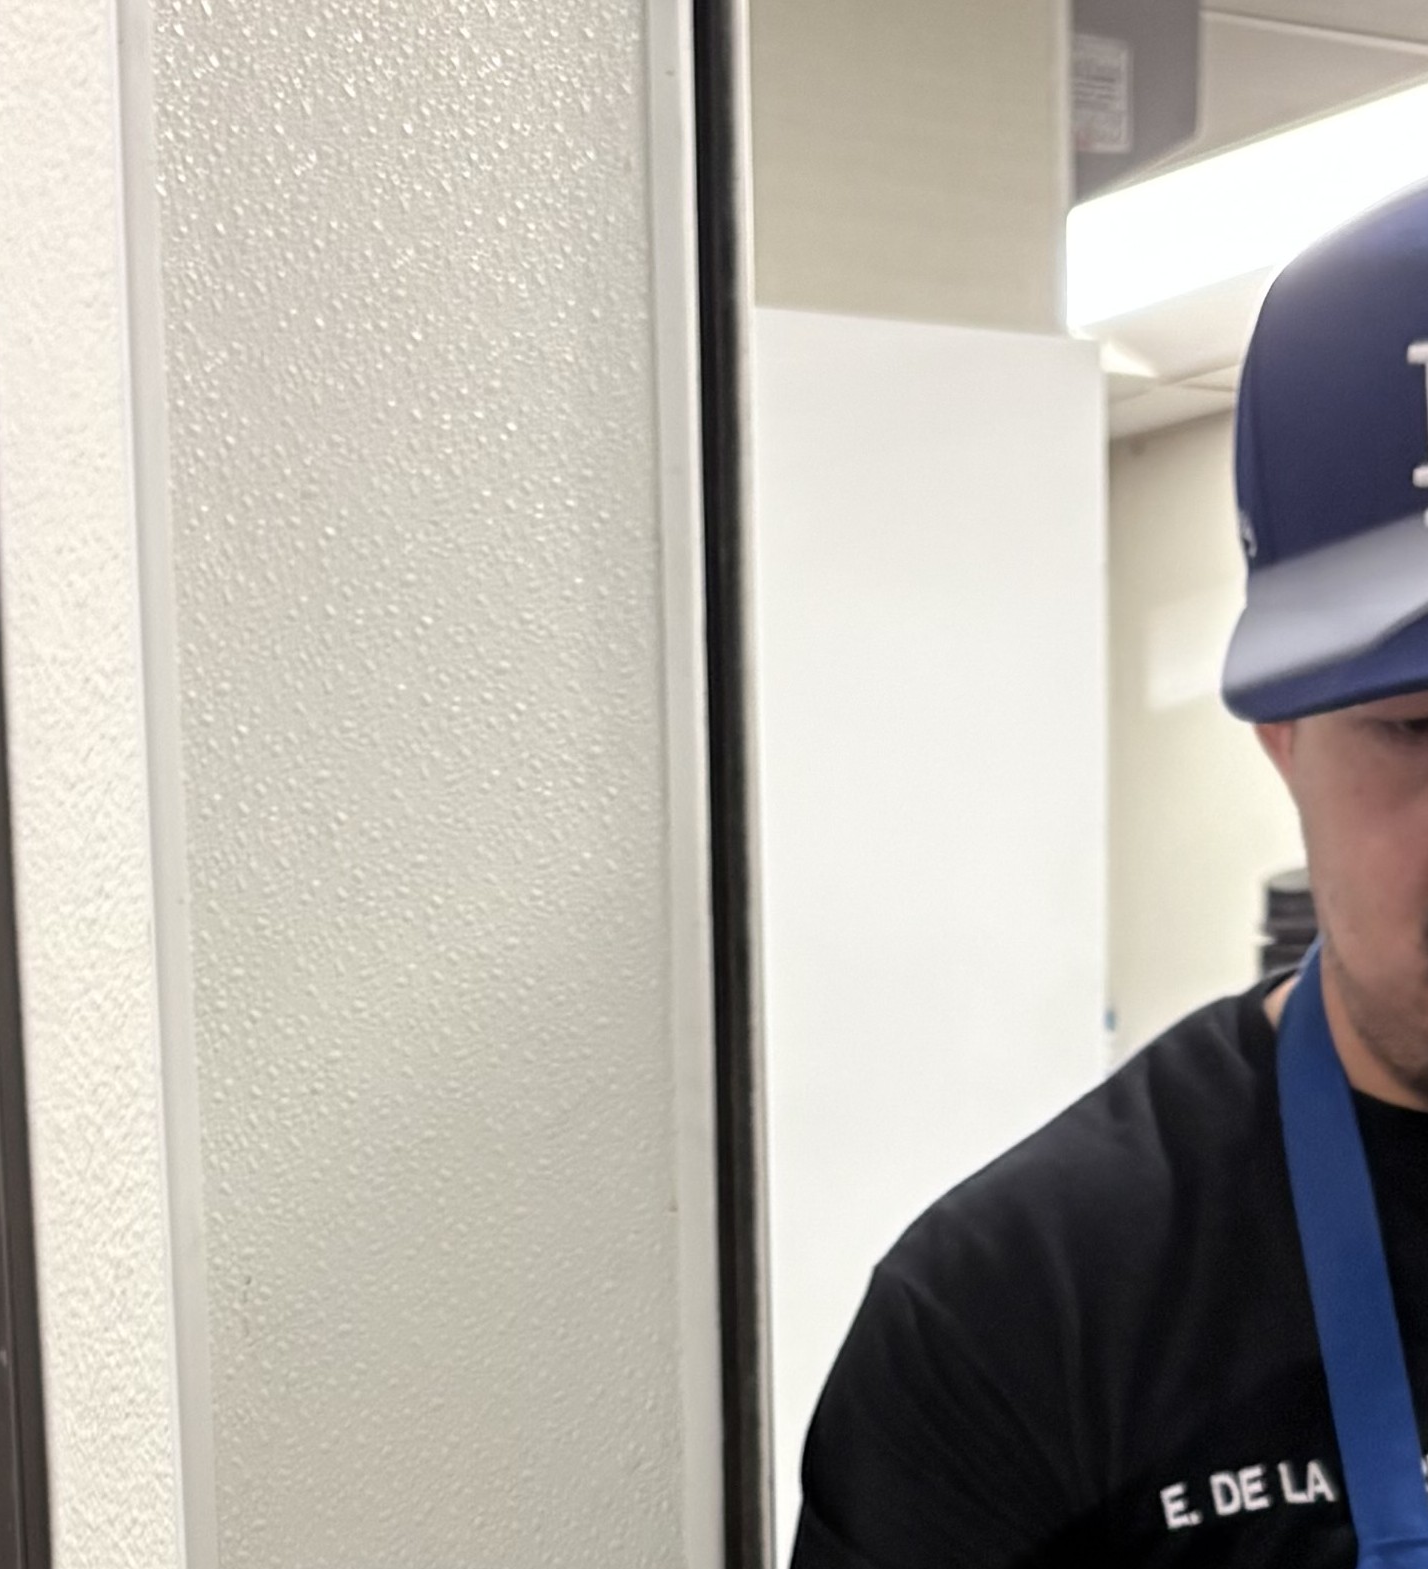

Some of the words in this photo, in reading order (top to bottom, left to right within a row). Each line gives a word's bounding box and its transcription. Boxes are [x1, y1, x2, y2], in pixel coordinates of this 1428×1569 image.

[1160, 1481, 1203, 1530] E.
[1209, 1464, 1270, 1516] DE
[1278, 1459, 1337, 1504] LA
